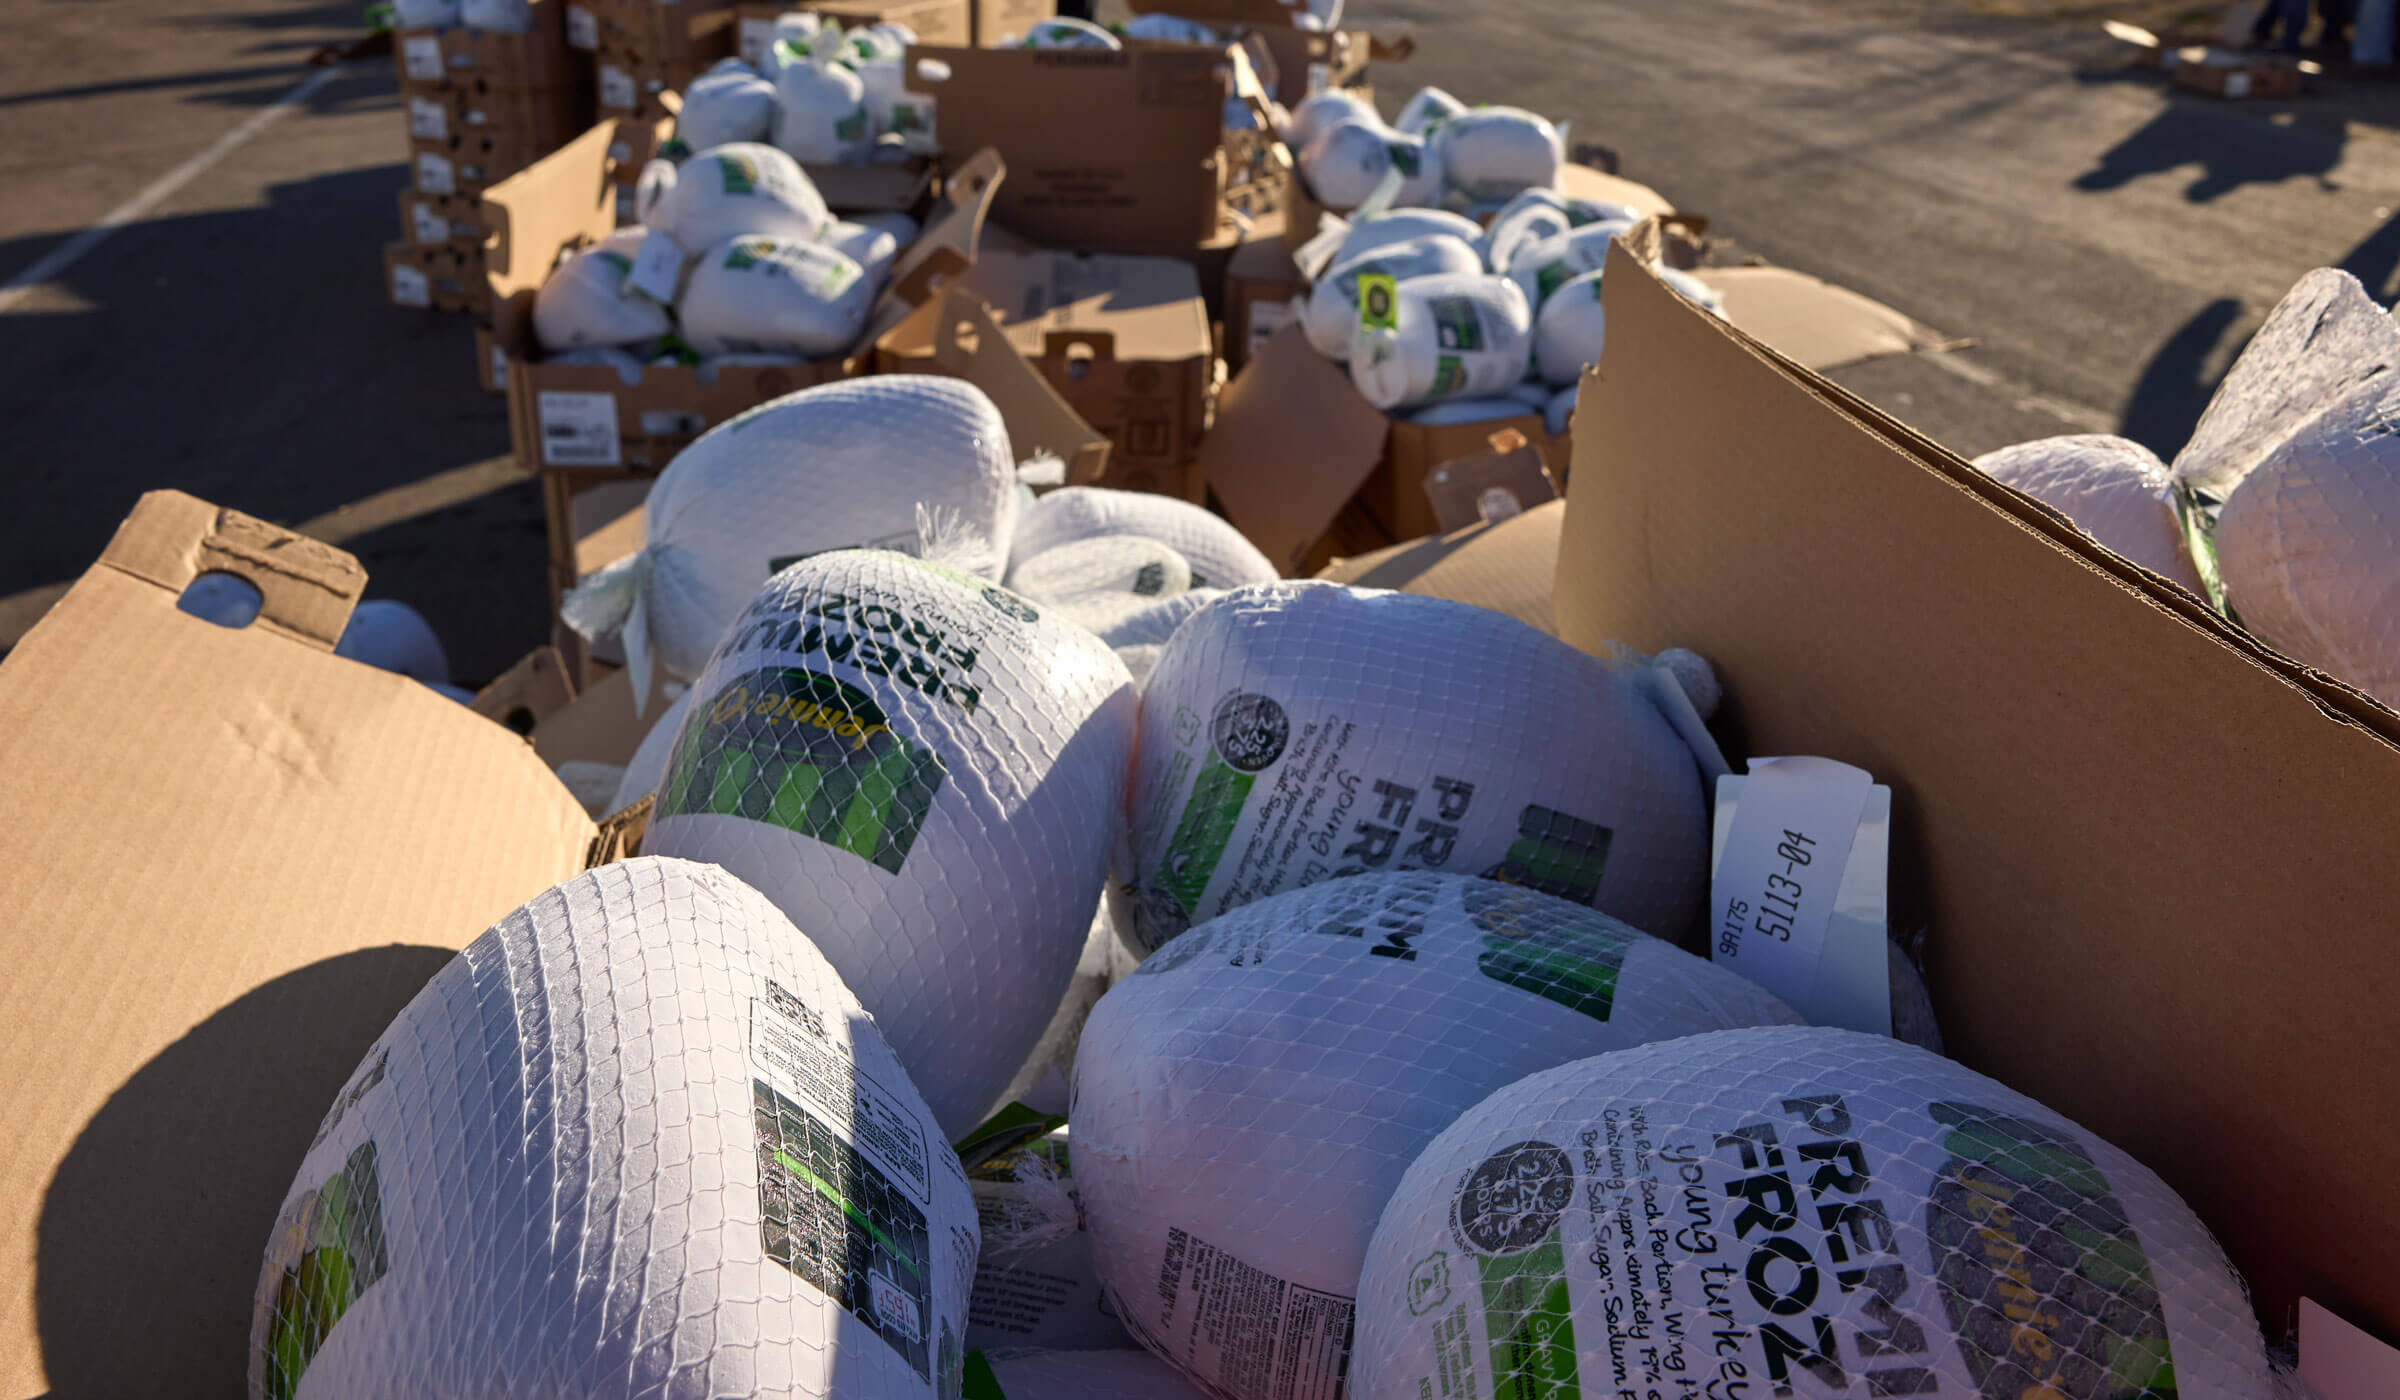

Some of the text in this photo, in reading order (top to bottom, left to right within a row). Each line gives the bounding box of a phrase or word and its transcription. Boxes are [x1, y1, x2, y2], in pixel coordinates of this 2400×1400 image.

[1308, 769, 1362, 857] young
[1330, 779, 1418, 878] FR
[1400, 776, 1476, 870] PR
[1719, 897, 1749, 957] 9A175
[1755, 828, 1817, 942] 5113-04
[1659, 1145, 1718, 1253] young
[1713, 1122, 1850, 1400] FROZ
[1603, 1296, 1628, 1386] Sodium
[1662, 1311, 1687, 1372] Wing
